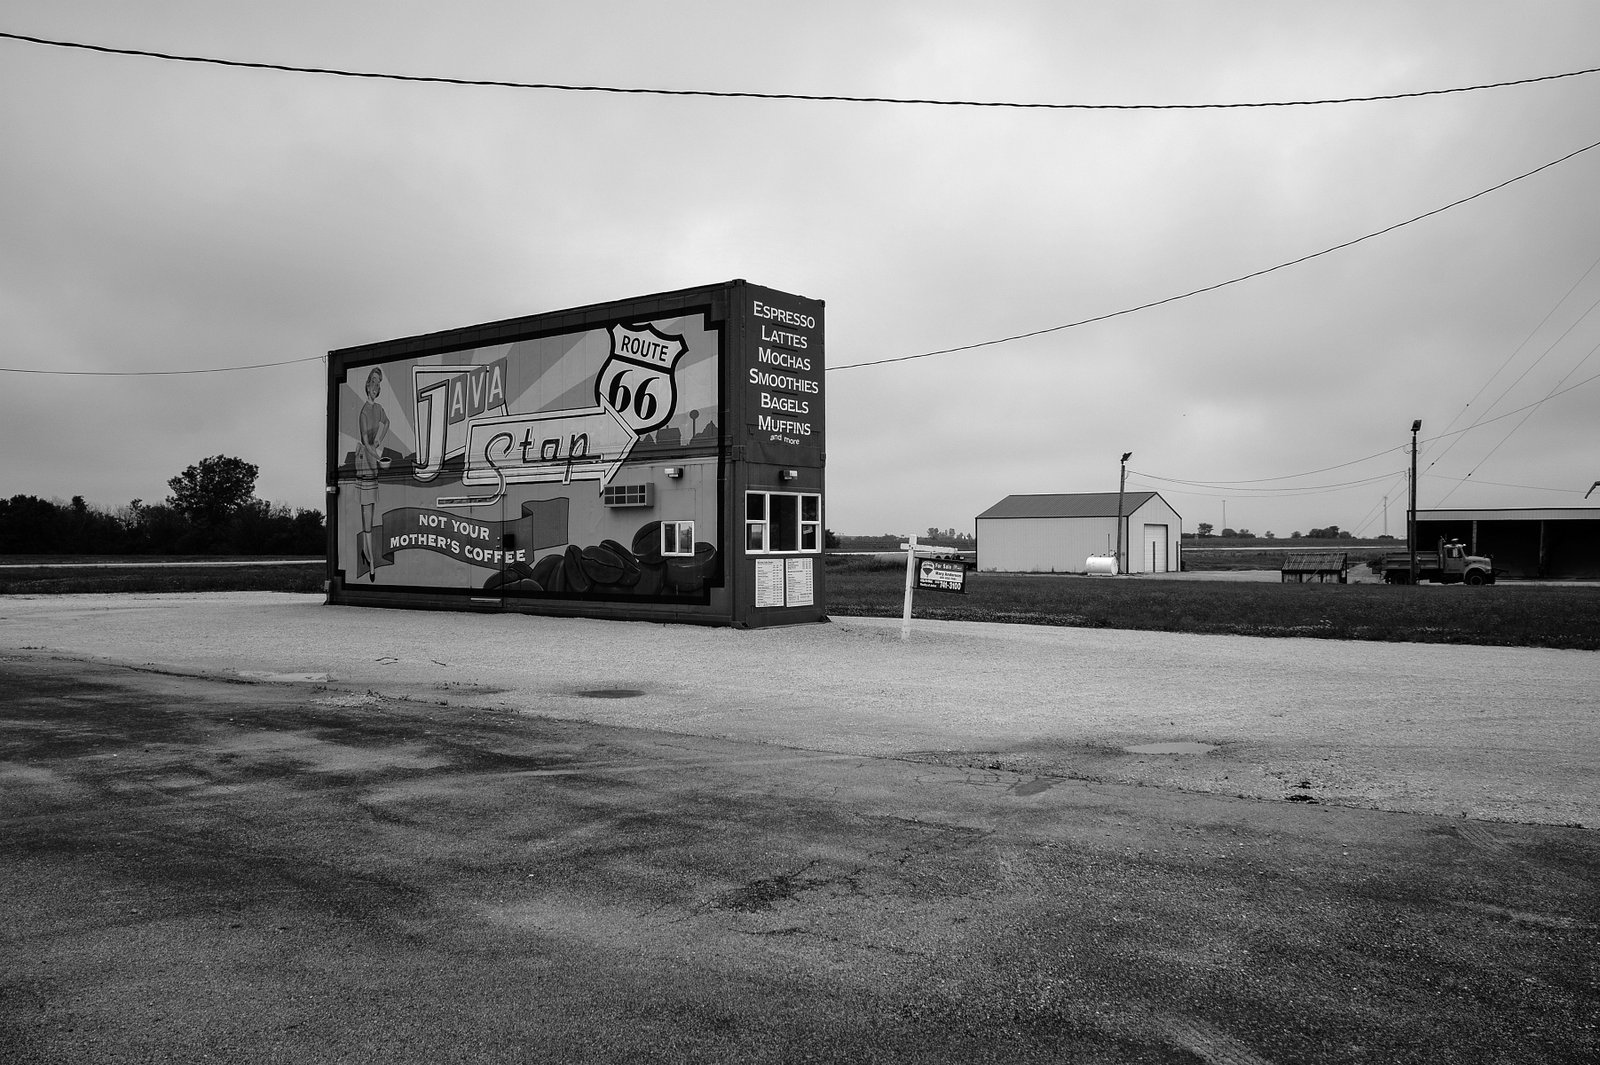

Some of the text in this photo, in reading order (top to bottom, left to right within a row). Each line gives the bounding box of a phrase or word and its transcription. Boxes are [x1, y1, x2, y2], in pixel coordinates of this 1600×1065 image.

[753, 300, 815, 329] ESPRESSO
[621, 335, 669, 362] ROUTE
[761, 325, 808, 348] LATTES
[758, 346, 811, 371] MOCHAS
[749, 368, 819, 394] SMOOTHIES
[608, 369, 660, 420] 66
[760, 392, 809, 414] BAGELS
[412, 366, 503, 482] JAVA
[758, 415, 811, 436] MUFFINS
[783, 436, 800, 445] more
[437, 426, 604, 507] Stop
[419, 514, 490, 540] NOT YOUR
[390, 533, 526, 563] MOTHER'S COFFEE
